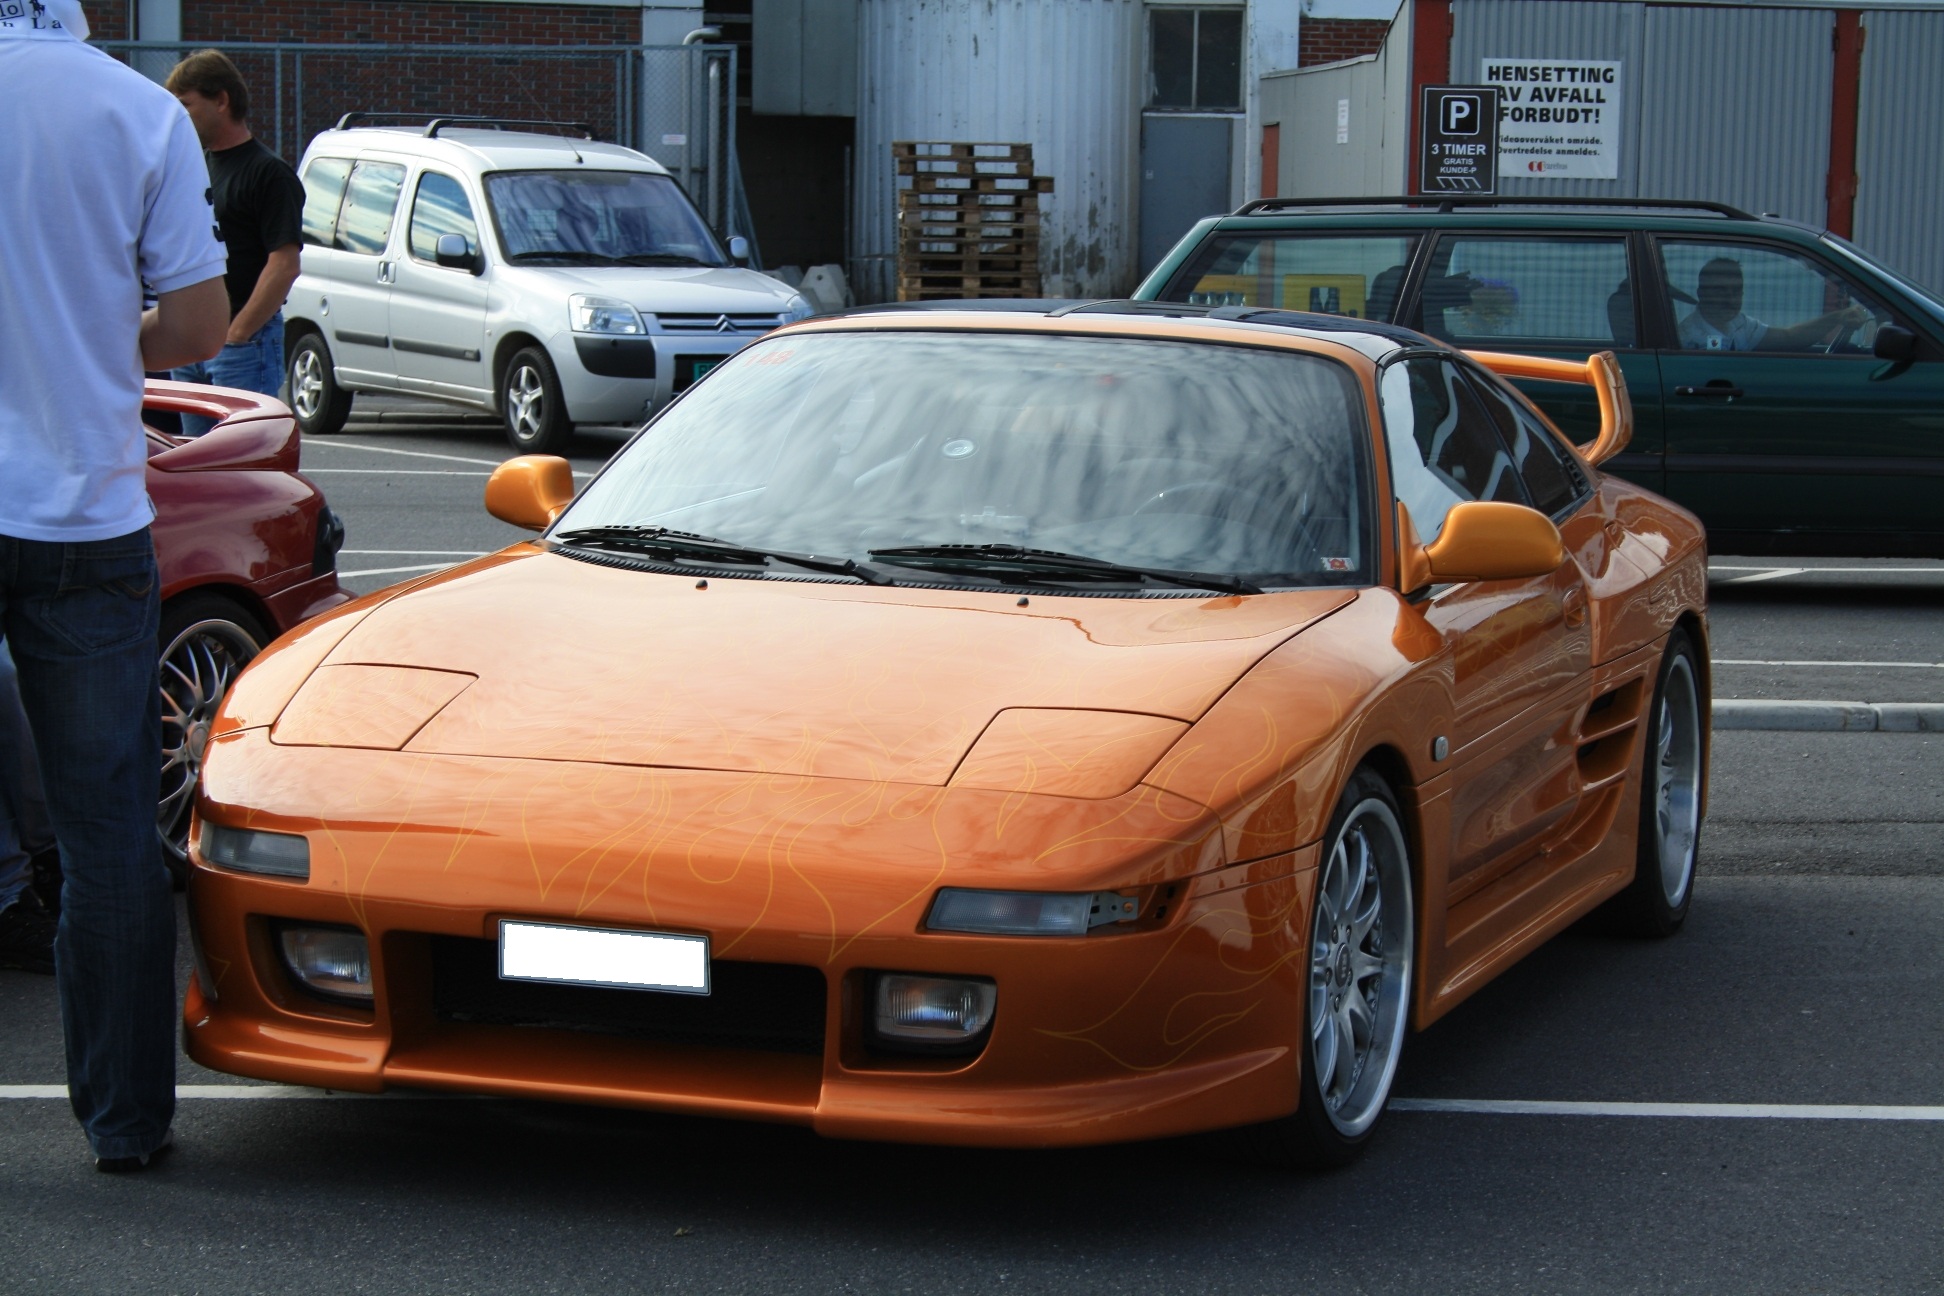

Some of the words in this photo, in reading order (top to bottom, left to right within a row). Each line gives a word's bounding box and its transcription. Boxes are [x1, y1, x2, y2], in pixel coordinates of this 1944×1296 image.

[1488, 66, 1614, 83] HENSETTING
[1499, 87, 1522, 101] AV
[1530, 87, 1606, 103] AVFALL
[1450, 100, 1470, 129] P
[1499, 107, 1600, 123] FORBUDT!
[1499, 135, 1564, 144] ideoovervåket
[1431, 144, 1439, 155] 3
[1442, 144, 1486, 155] TIMER
[1556, 147, 1600, 156] anmeldes.
[1440, 166, 1477, 174] KUNDE-P
